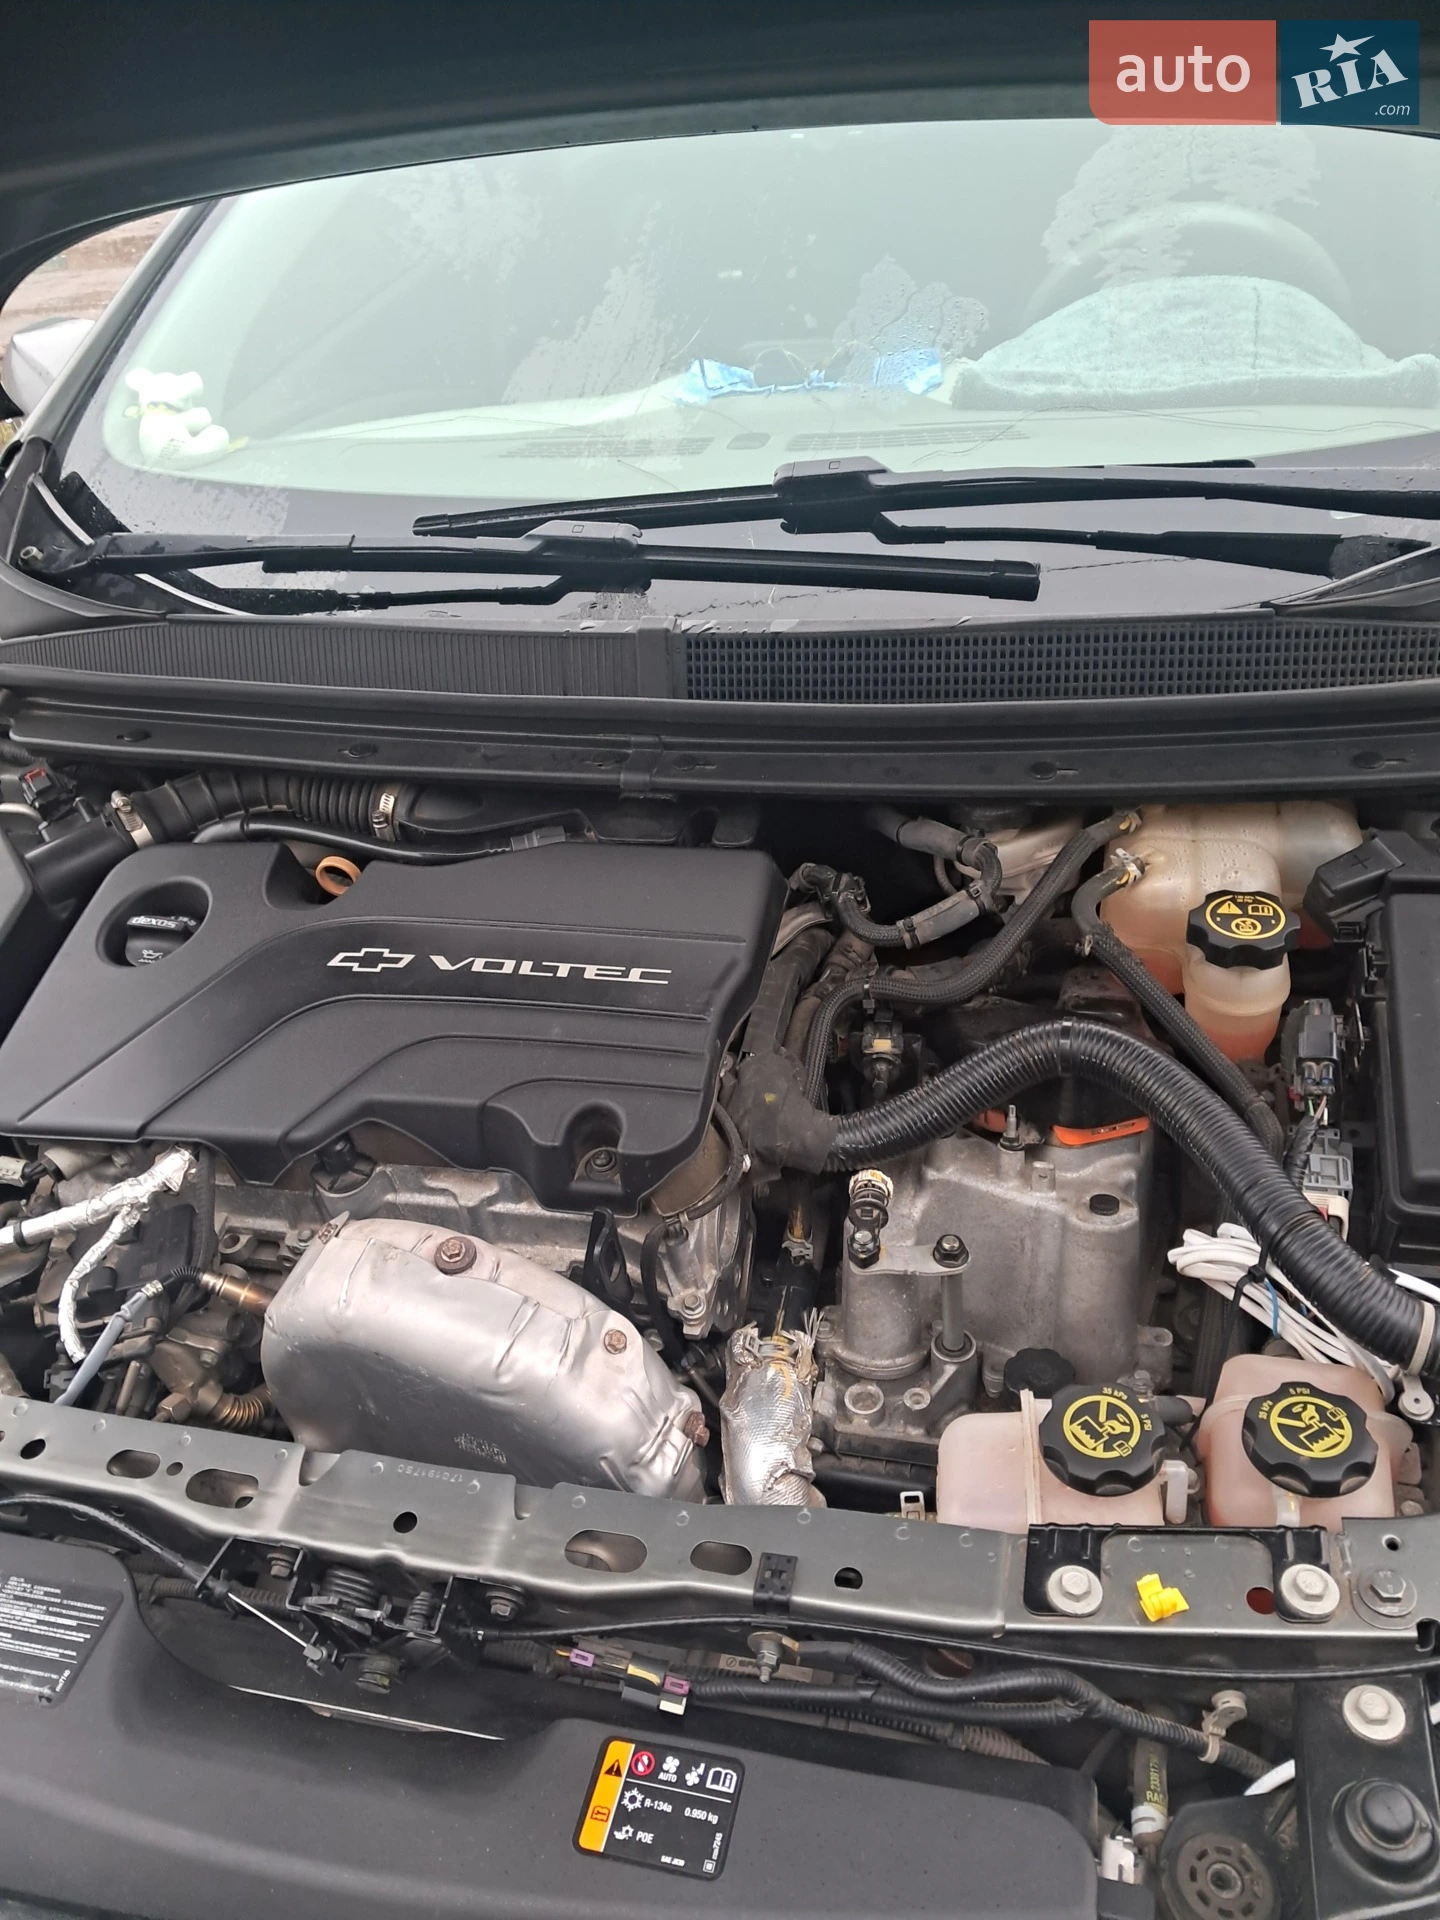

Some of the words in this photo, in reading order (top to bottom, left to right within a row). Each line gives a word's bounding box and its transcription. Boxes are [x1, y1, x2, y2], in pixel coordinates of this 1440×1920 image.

[131, 915, 178, 929] dexos
[428, 954, 673, 985] VOLTEC
[1101, 1386, 1113, 1395] 35
[658, 1772, 677, 1783] AUTO
[644, 1798, 673, 1813] R-134a
[684, 1807, 707, 1820] 0.950
[707, 1811, 719, 1825] kg
[636, 1831, 654, 1844] POE
